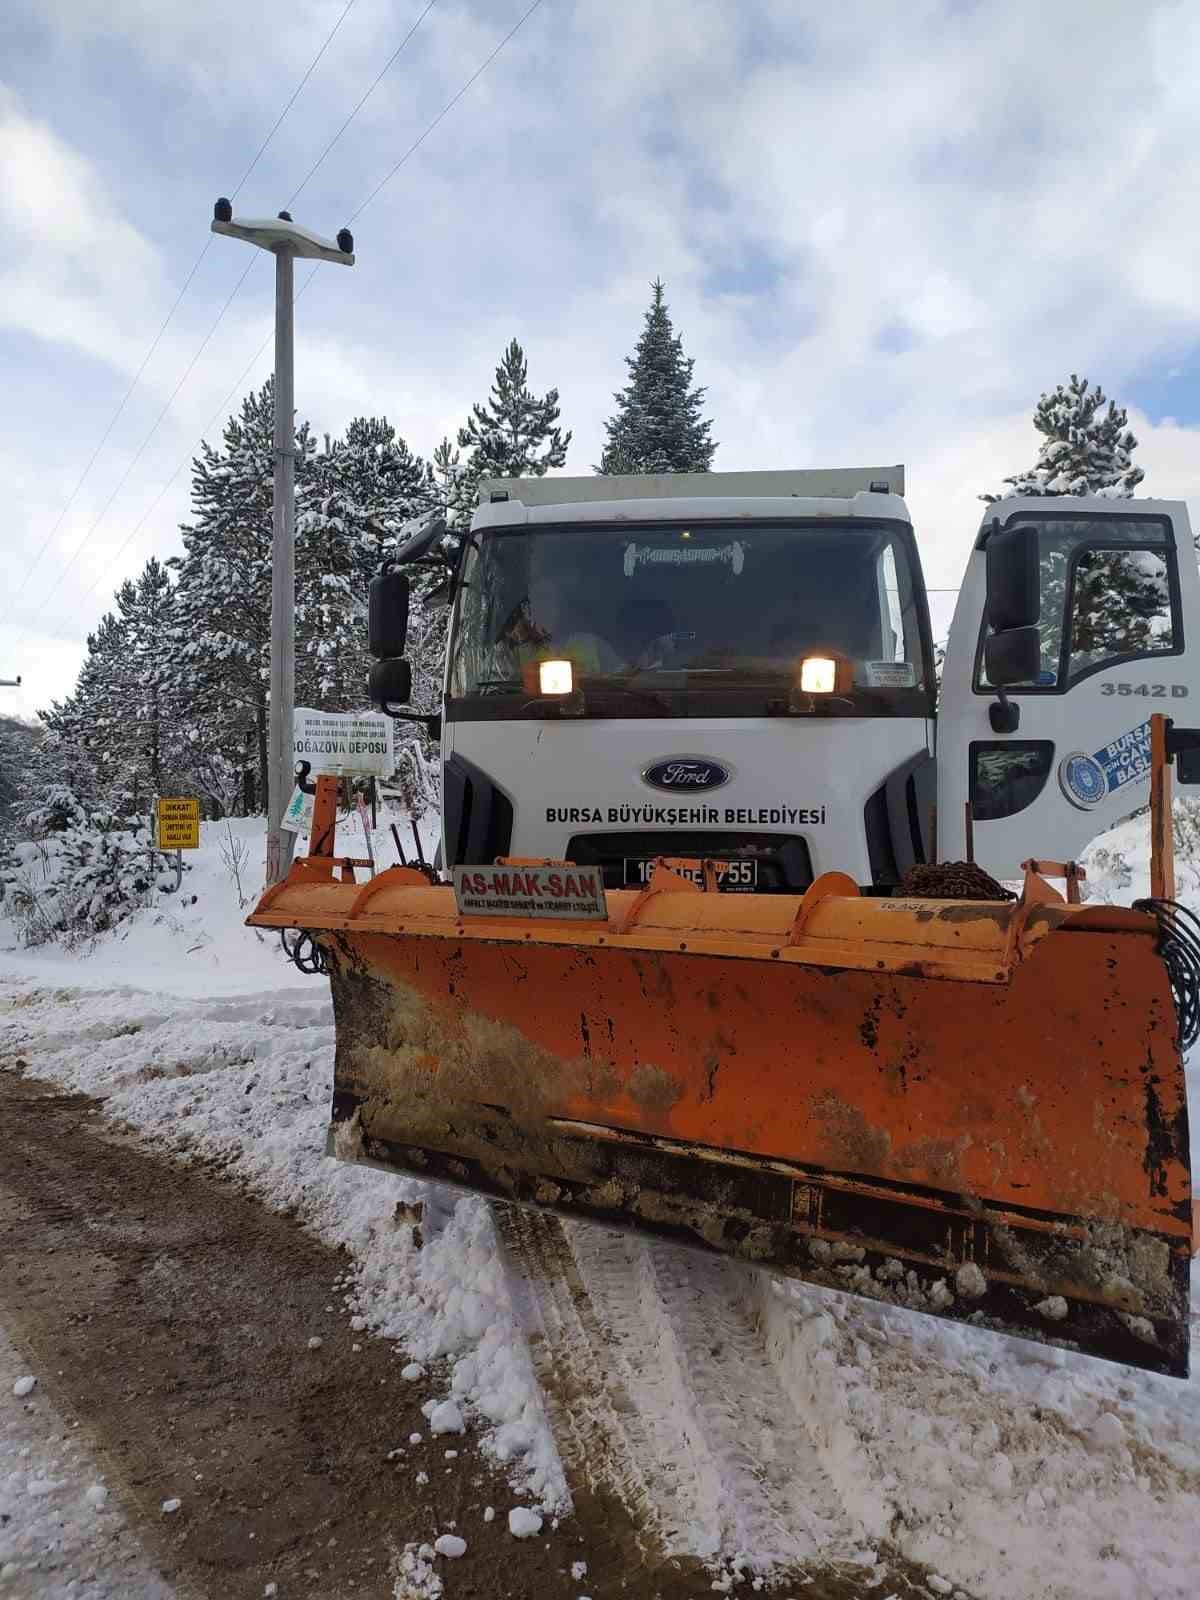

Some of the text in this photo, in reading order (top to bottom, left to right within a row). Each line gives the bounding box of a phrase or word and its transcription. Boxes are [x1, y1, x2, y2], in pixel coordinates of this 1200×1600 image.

[1101, 683, 1189, 698] 3542 D
[349, 741, 388, 754] DEPOSU
[1106, 723, 1152, 759] BURSA
[1119, 736, 1152, 767] CAN
[662, 763, 711, 784] Ford
[546, 803, 827, 826] BURSA BÜYÜKŞEHİR BELEDİYESİ
[638, 861, 655, 883] 16
[672, 866, 703, 884] GE
[460, 871, 598, 898] AS-MAK-SAN
